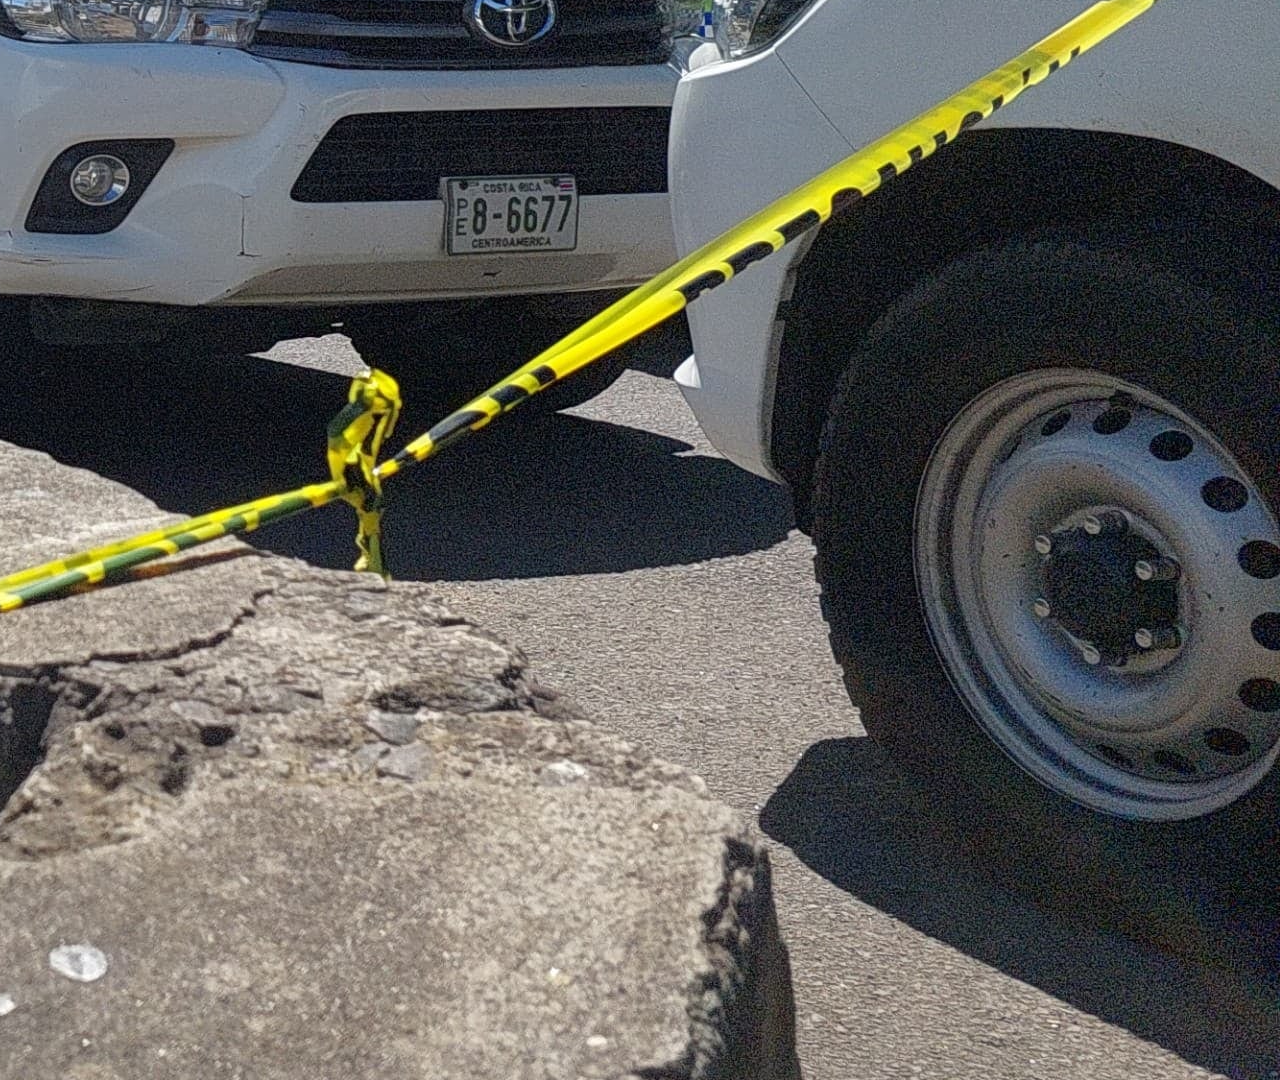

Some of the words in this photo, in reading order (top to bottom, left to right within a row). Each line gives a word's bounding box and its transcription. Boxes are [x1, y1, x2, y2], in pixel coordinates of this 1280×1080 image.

[483, 183, 516, 194] COSTA
[517, 182, 542, 193] RICA
[472, 194, 573, 235] 8-6677
[472, 236, 552, 249] CENTROAMERICA
